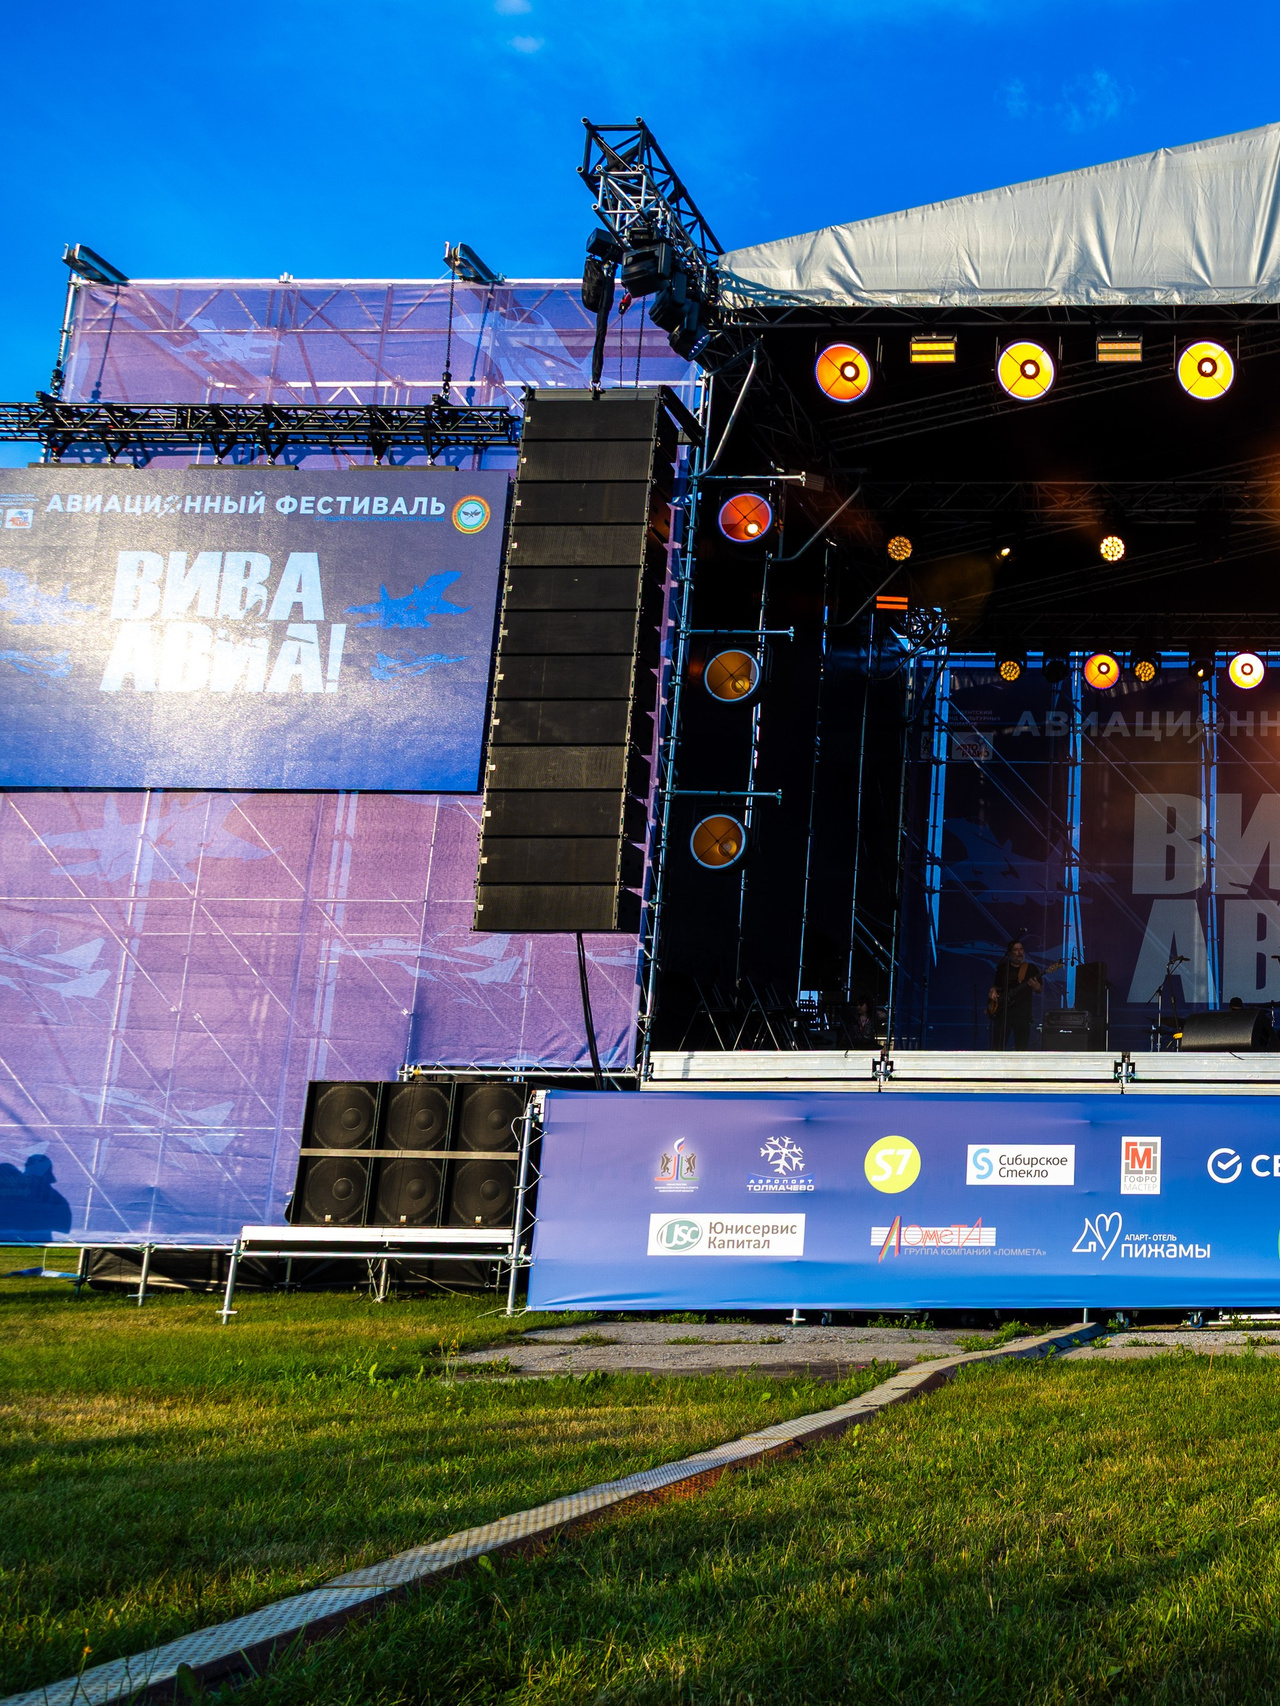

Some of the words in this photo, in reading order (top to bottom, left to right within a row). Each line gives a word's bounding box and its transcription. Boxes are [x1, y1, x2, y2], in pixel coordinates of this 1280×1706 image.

[45, 491, 266, 517] АВИАЦИОННЫЙ
[276, 495, 447, 516] ФЕСТИВАЛЬ
[111, 550, 325, 621] ВИВА
[99, 622, 347, 693] АВИА!
[871, 1148, 913, 1182] S7
[999, 1154, 1068, 1168] Сибирское
[998, 1167, 1048, 1178] Стекло
[1123, 1183, 1157, 1191] МАСТЕР
[662, 1224, 699, 1246] USC
[708, 1222, 797, 1237] Юнисервис
[708, 1236, 770, 1249] Капитал
[904, 1248, 939, 1256] ГРУППА
[941, 1247, 991, 1256] КОМПАНИЙ
